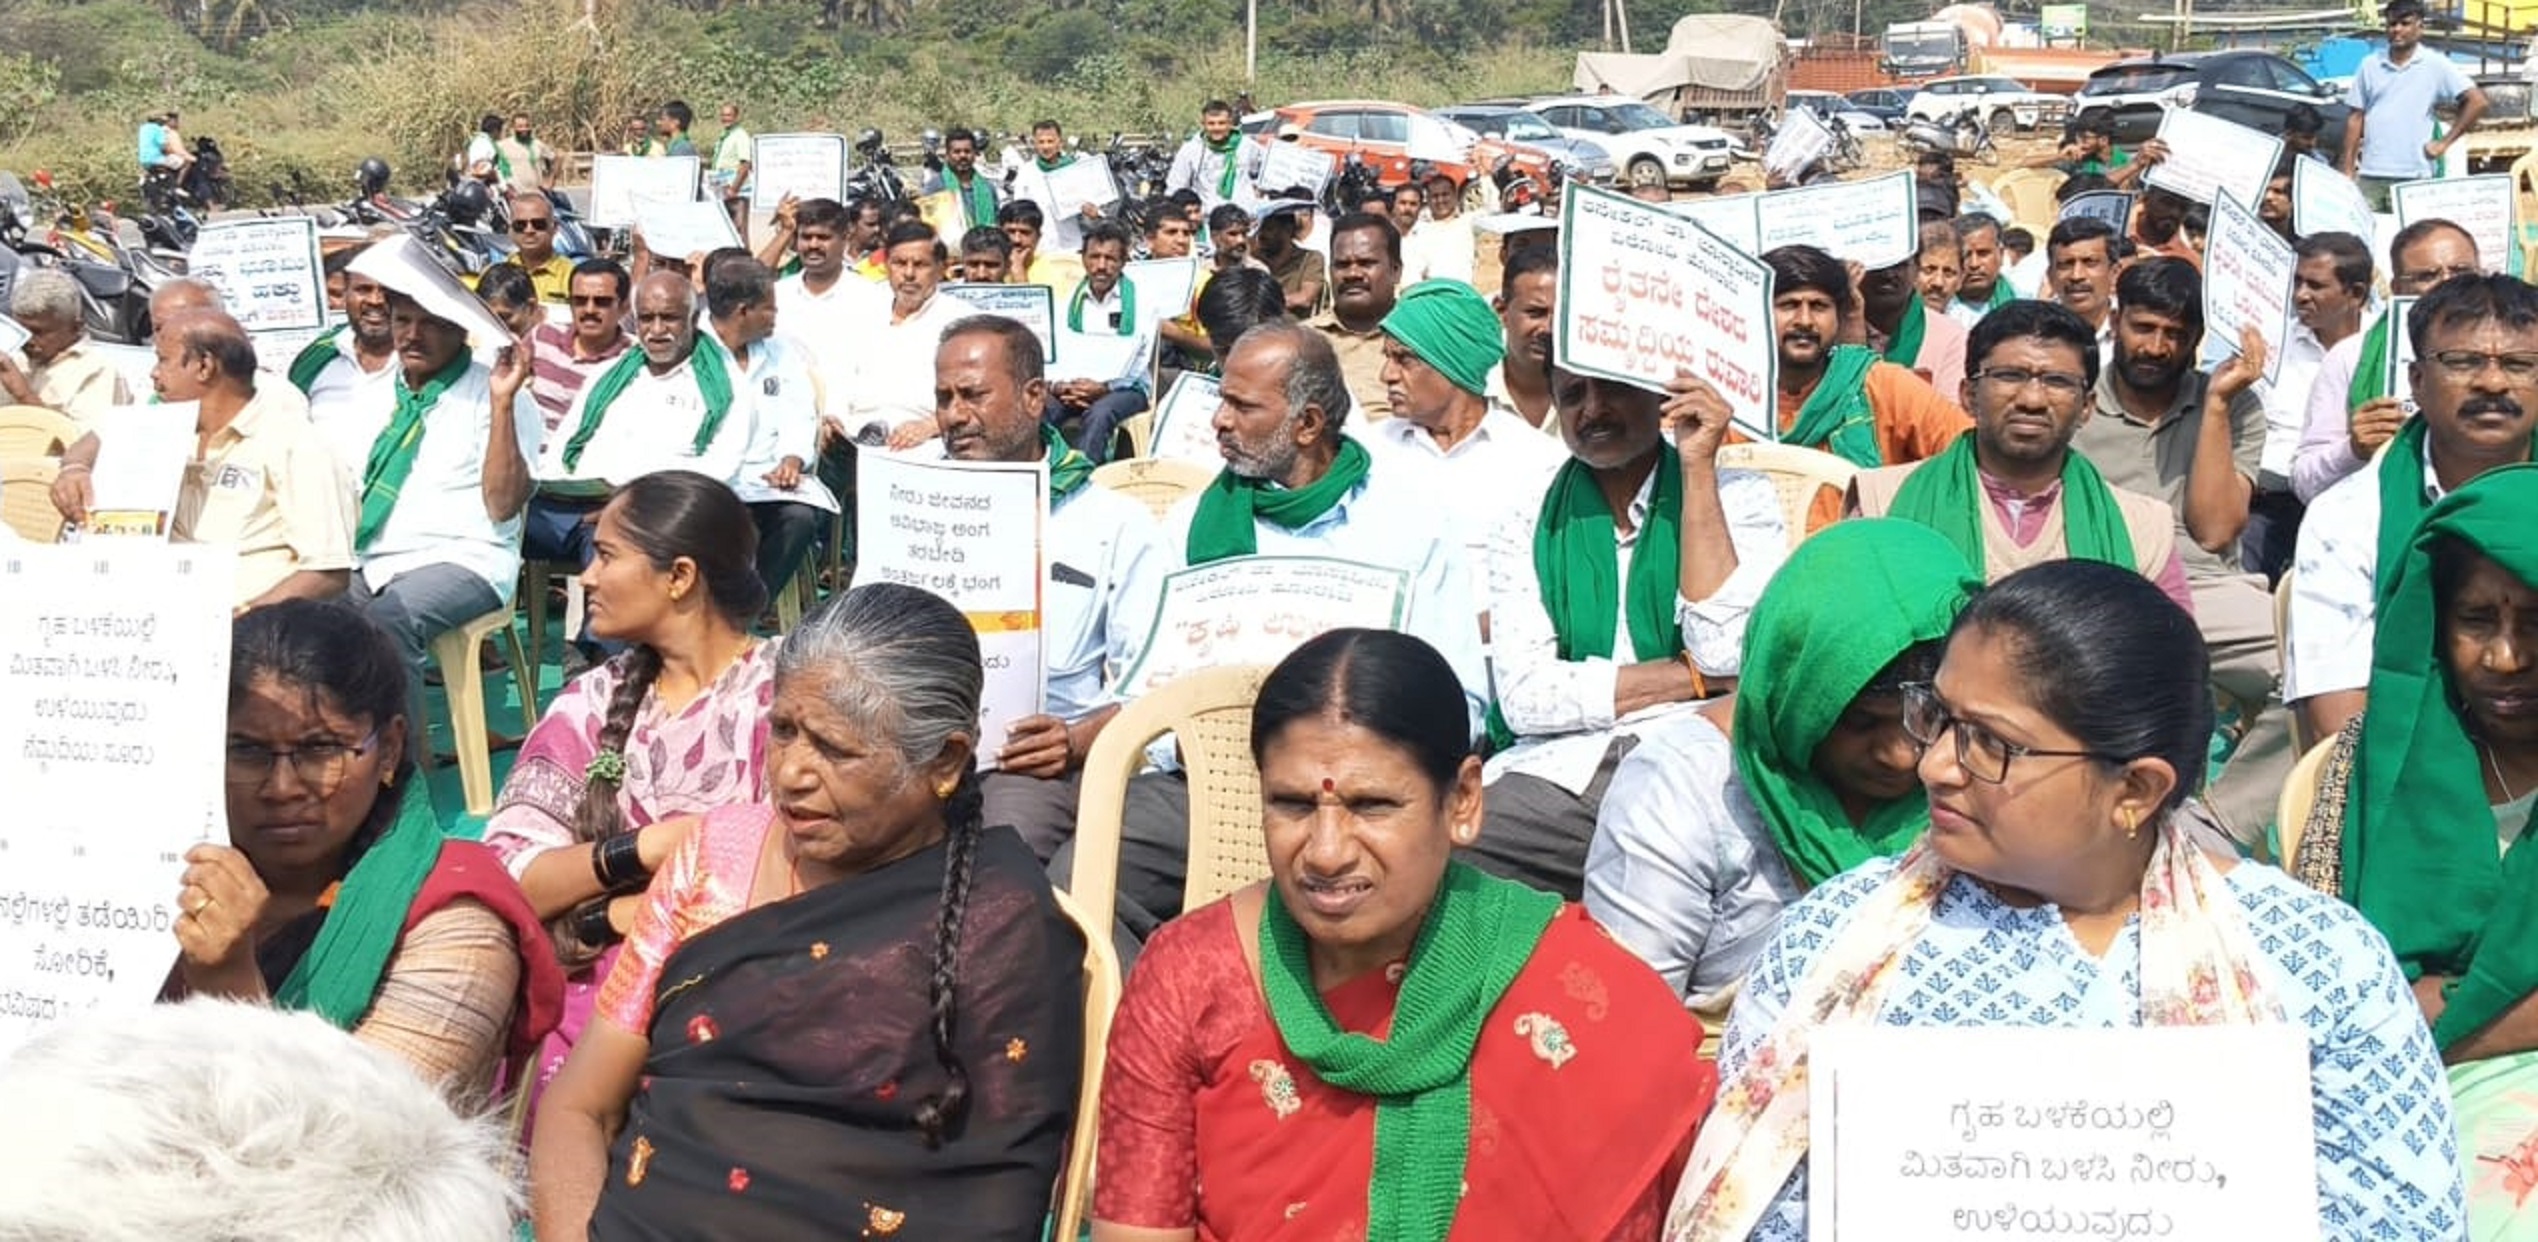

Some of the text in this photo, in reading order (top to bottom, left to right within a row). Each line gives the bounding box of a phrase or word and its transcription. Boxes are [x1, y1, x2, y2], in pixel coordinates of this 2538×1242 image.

[890, 483, 924, 505] ನೀರು
[952, 522, 991, 538] ಅಂಗ
[38, 611, 156, 648] ಗೃಹ ಬಳಕೆಯಲ್ಲಿ
[9, 653, 178, 686] ಮಿತವಾಗಿ ಬಳಸಿ ನೀರು,
[35, 695, 149, 727] ಉಳಿಯುವುದು
[33, 943, 115, 983] ಸೋರಿಕೆ,
[1950, 1099, 2175, 1143] ಗೃಹ ಬಳಕೆಯಲ್ಲಿ
[1900, 1150, 2227, 1190] ಮಿತವಾಗಿ ಬಳಸಿ ನೀರು,
[1953, 1203, 2173, 1241] ಉಳಿಯುವುದು
